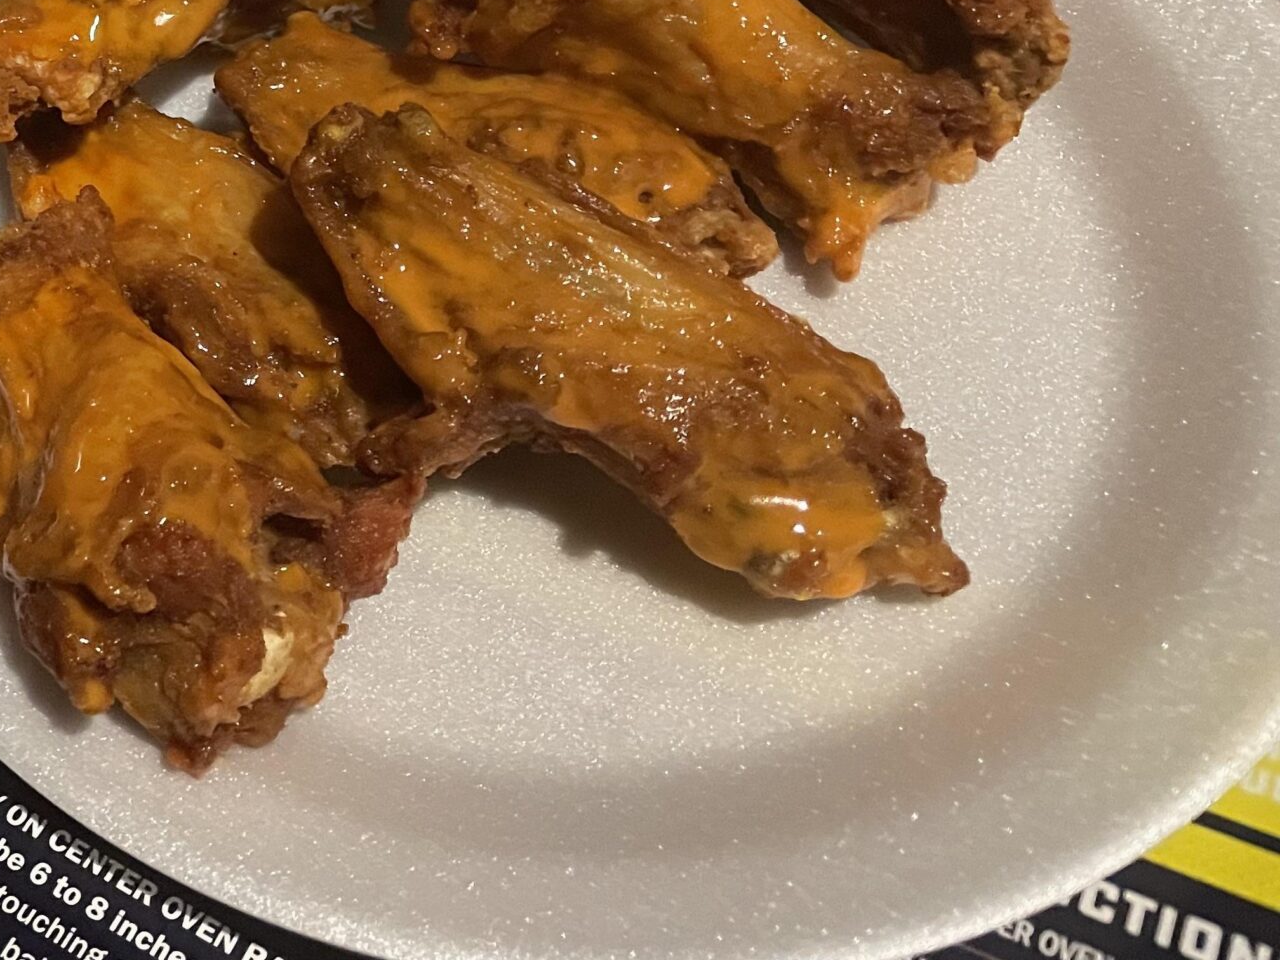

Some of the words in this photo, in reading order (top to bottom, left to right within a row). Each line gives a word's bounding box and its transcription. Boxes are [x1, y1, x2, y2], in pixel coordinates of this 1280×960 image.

[5, 803, 49, 840] ON
[47, 829, 159, 907] CENTER
[160, 896, 241, 955] OVEN
[29, 862, 52, 885] 6
[51, 875, 82, 906] to
[84, 896, 109, 922] 8
[1058, 879, 1273, 960] CTION
